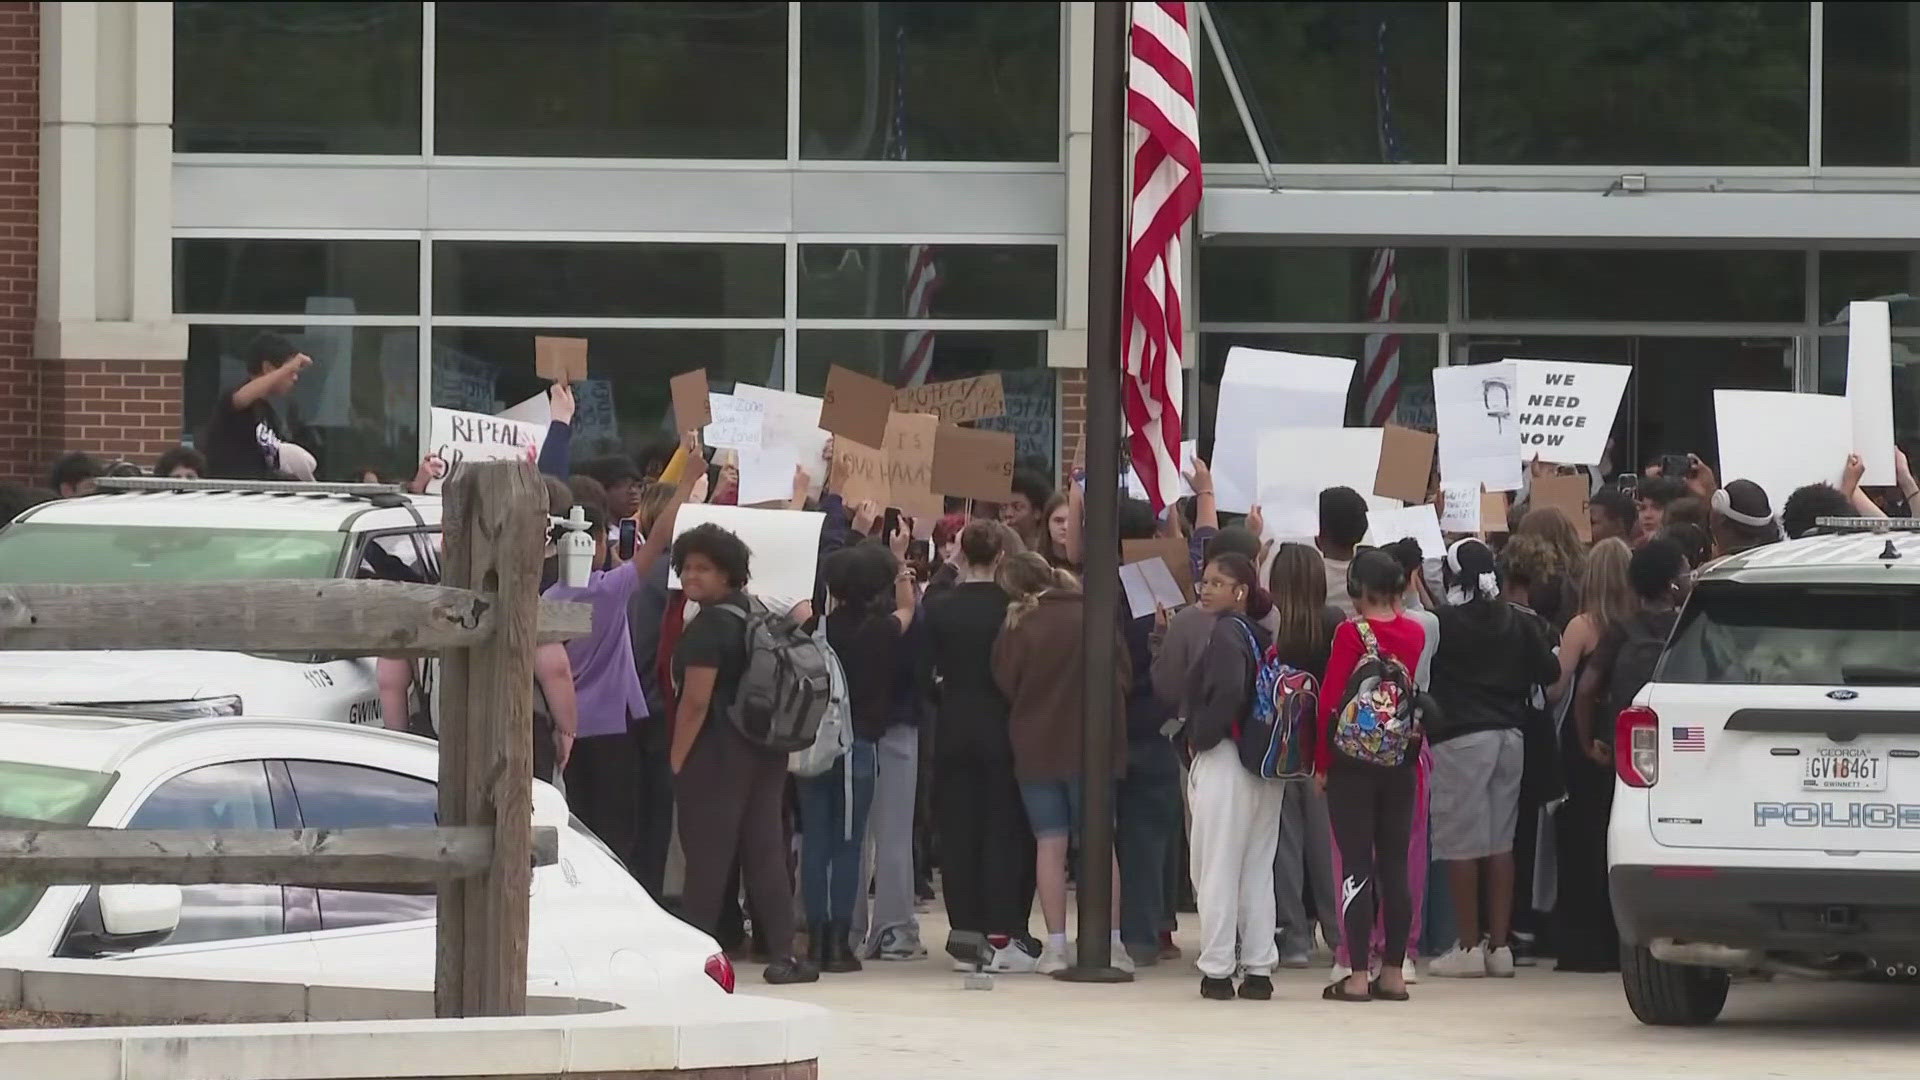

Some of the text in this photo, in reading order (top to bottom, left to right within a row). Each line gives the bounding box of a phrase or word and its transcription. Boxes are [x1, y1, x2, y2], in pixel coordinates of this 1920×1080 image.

[1545, 373, 1575, 386] WE
[1528, 394, 1580, 408] NEED
[1519, 413, 1587, 428] HANGE
[451, 415, 525, 448] REPEAL
[304, 669, 334, 688] 1179
[349, 699, 382, 724] GWIN
[1820, 748, 1867, 757] GEORGIA
[1812, 757, 1880, 779] GV1846T
